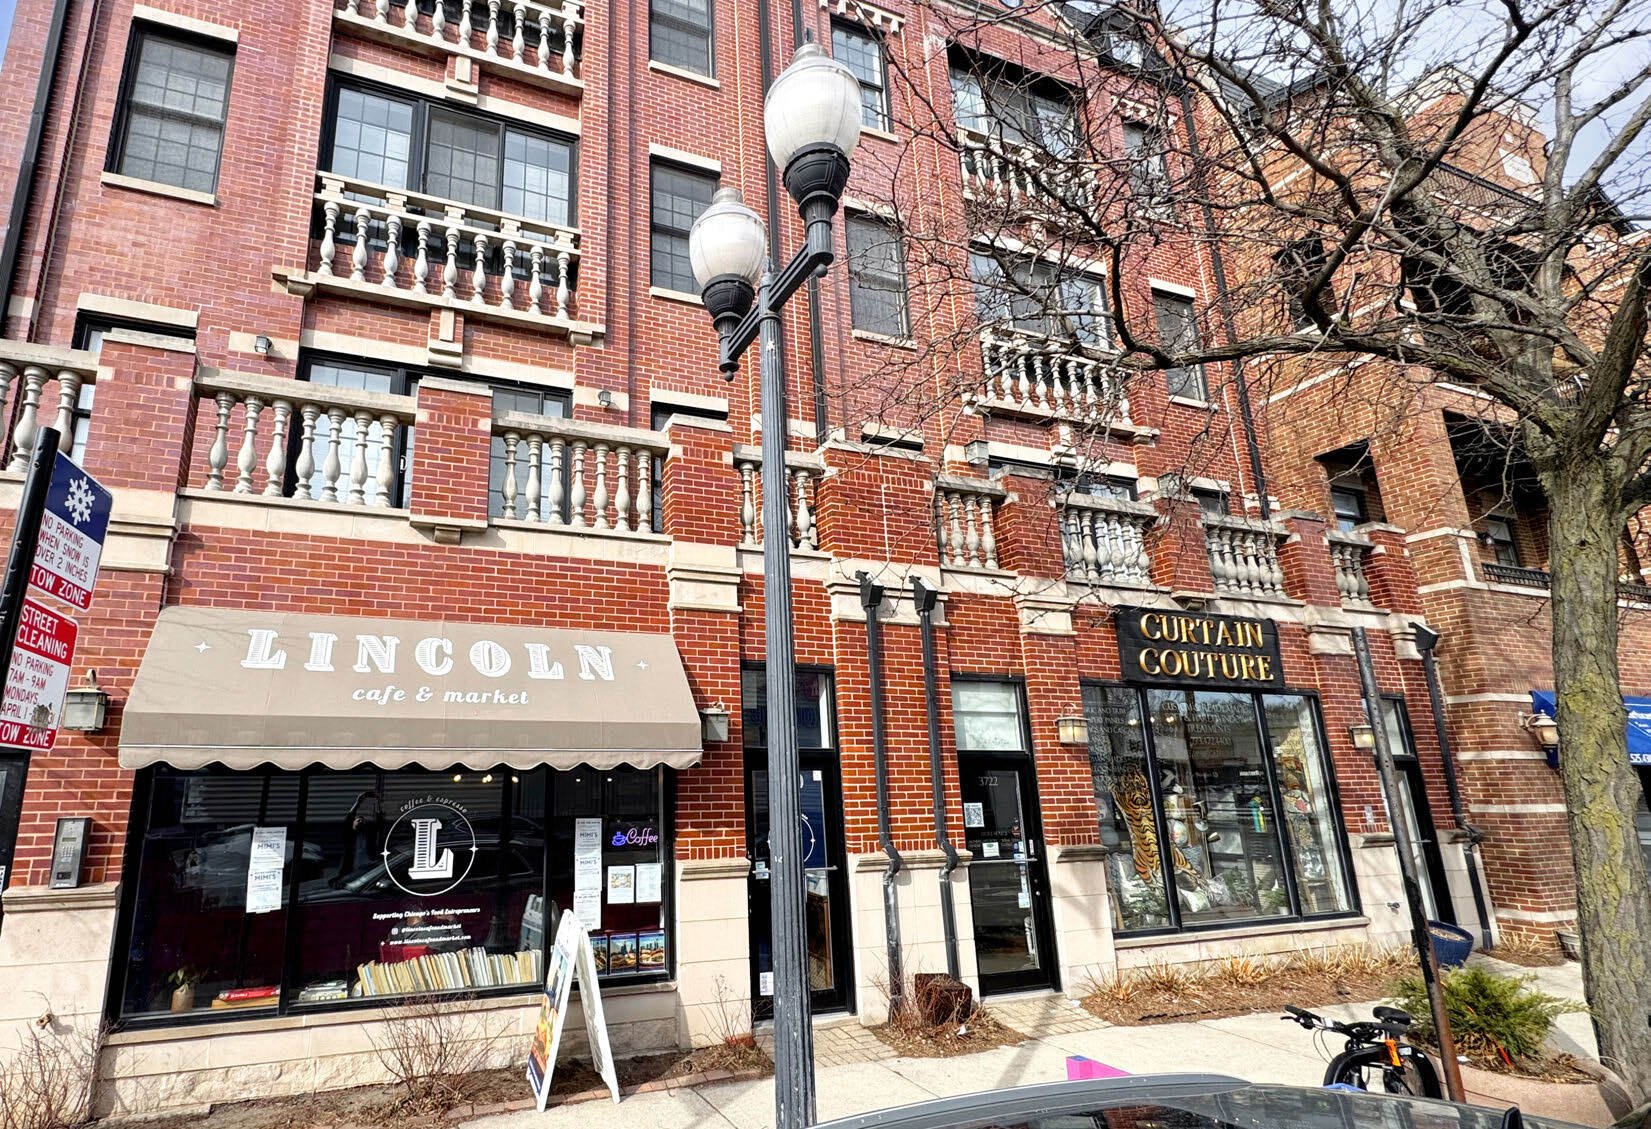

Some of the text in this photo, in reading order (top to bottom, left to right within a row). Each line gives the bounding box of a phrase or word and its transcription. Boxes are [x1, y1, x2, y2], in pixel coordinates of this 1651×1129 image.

[42, 513, 84, 549] NO PARKING
[35, 544, 88, 583] OVER 2 INCHES
[39, 529, 90, 568] WHEN SNOW IS
[31, 565, 87, 606] TOW ZONE
[21, 604, 59, 635] STREET
[1140, 613, 1264, 649] CURTAIN
[17, 624, 68, 659] CLEANING
[240, 629, 615, 681] LINCOLN
[10, 668, 25, 684] 7AM
[31, 675, 47, 690] 9AM
[12, 651, 54, 677] NO PARKING
[1139, 647, 1274, 681] COUTURE
[4, 684, 39, 704] MONDAYS
[352, 686, 529, 705] cafe & market
[1, 702, 21, 719] APRIL
[24, 726, 52, 747] ZONE
[400, 799, 423, 812] coffee
[435, 796, 468, 813] espresso
[408, 818, 454, 880] L
[626, 827, 659, 846] Coffee
[372, 907, 481, 920] Supporting Chicago's Food Entrepreneurs
